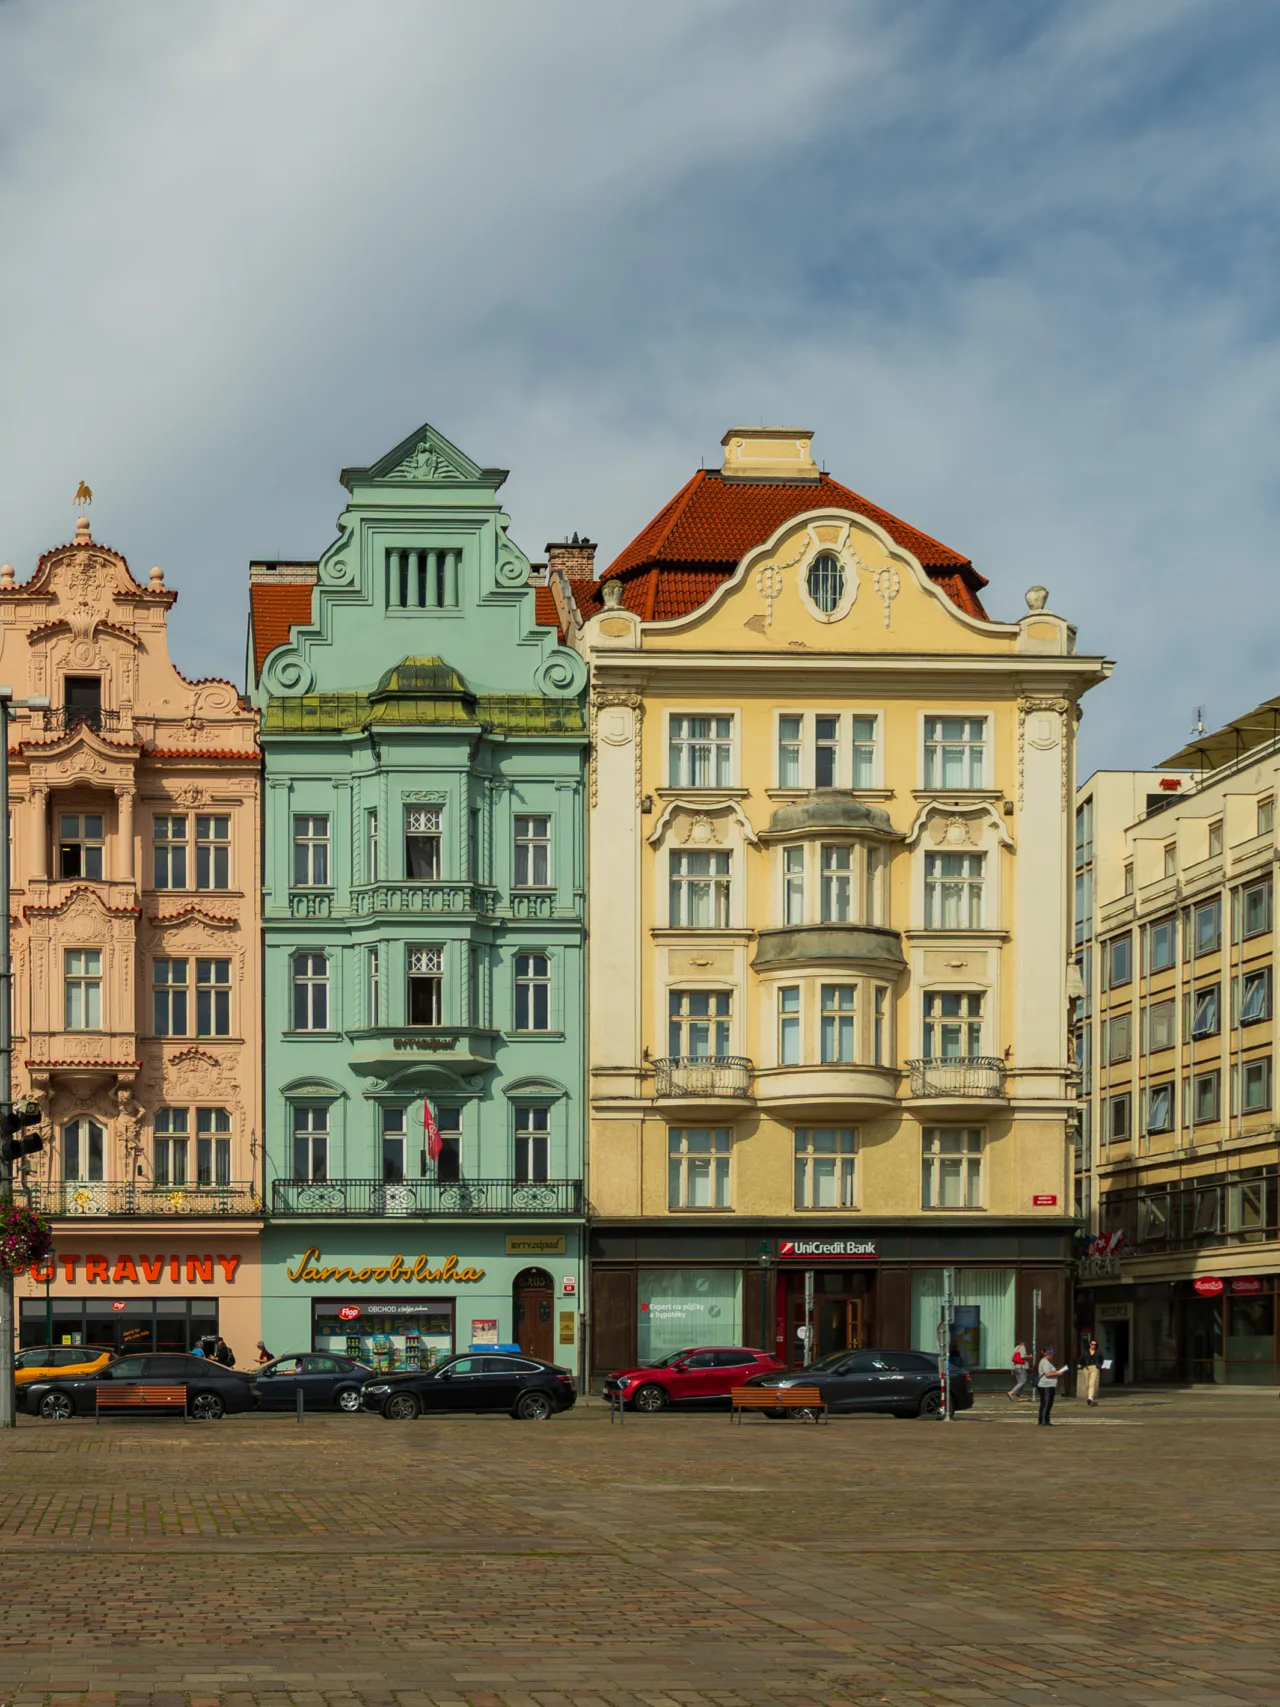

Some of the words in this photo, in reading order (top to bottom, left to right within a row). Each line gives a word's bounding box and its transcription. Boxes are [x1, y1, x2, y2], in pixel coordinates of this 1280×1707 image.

[794, 1242, 845, 1254] UniCredit
[846, 1242, 876, 1254] Bank
[14, 1254, 241, 1281] OTRAVINY
[287, 1247, 485, 1281] Samoobsluha
[341, 1308, 359, 1317] Flop
[650, 1303, 672, 1311] Expert
